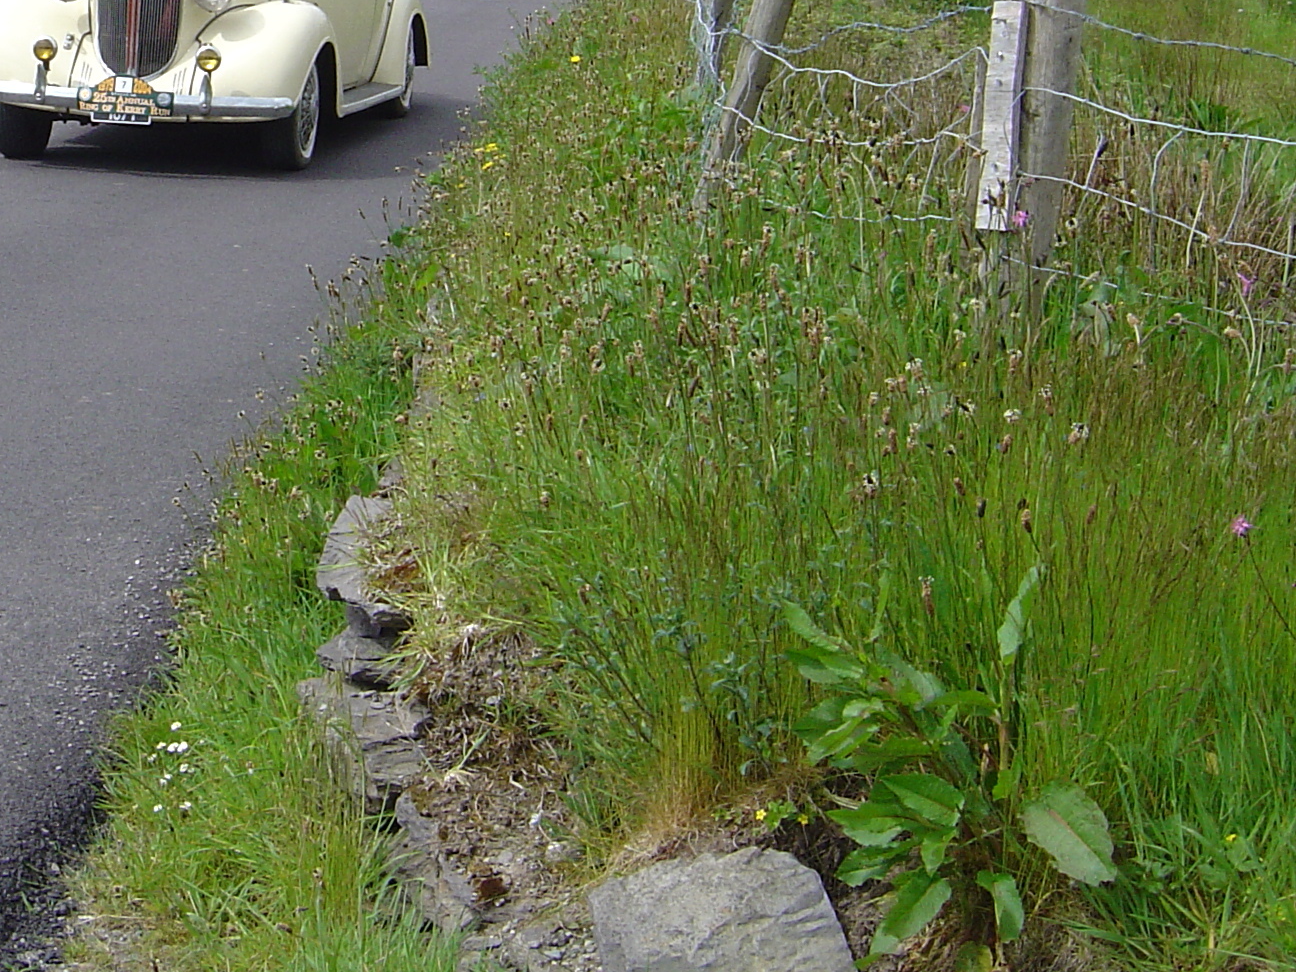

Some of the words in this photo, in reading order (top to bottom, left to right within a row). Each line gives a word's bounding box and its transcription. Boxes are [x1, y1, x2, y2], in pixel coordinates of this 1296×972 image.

[122, 81, 127, 89] 7
[79, 101, 99, 111] RING
[102, 103, 114, 112] OF
[116, 103, 146, 114] KERRY
[150, 106, 171, 116] RUN
